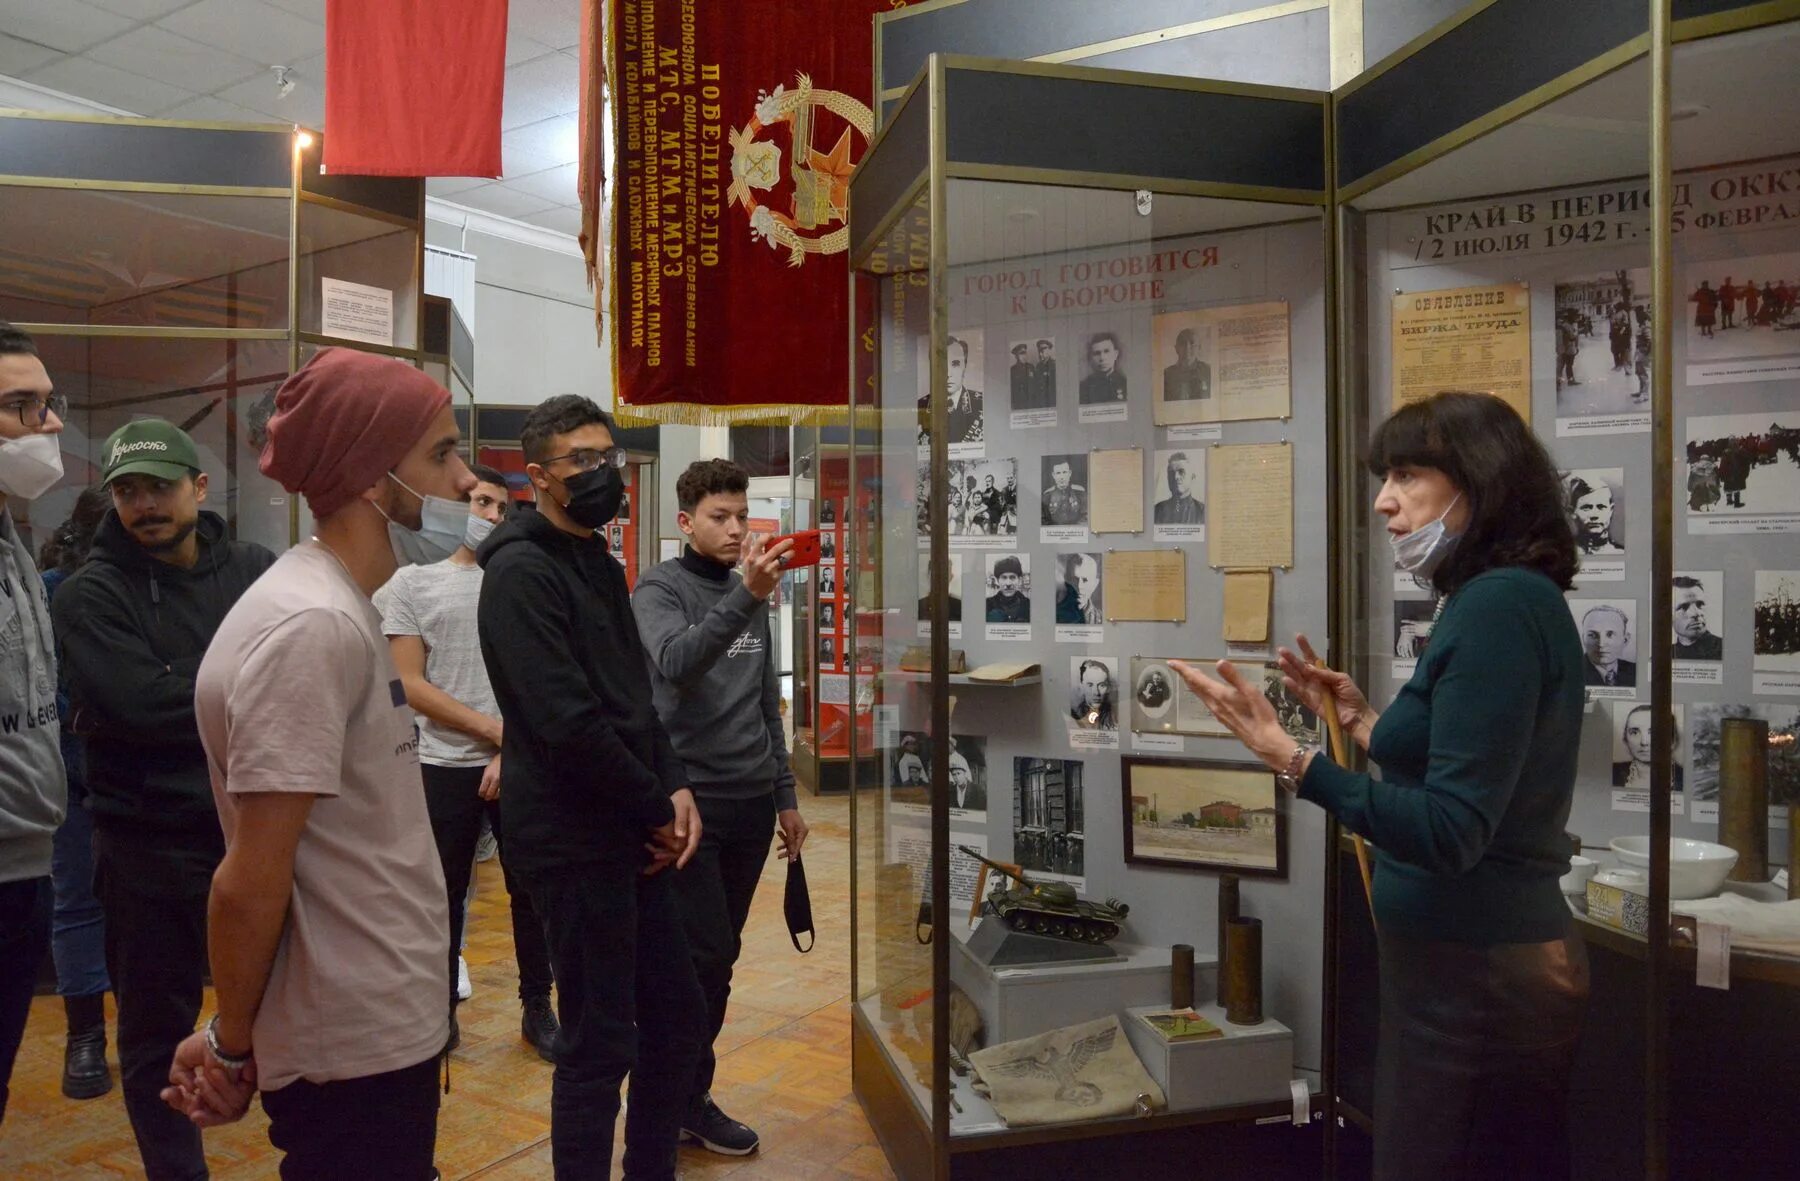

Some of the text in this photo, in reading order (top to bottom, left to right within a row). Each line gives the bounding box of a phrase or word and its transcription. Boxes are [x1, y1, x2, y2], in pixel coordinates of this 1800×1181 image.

[625, 0, 637, 51] МОНТА
[658, 45, 681, 113] МТС,
[628, 159, 637, 169] И
[641, 0, 661, 367] ПОЛНЕНИЕ И ПЕРЕВЫПОЛНЕНИЕ МЕСЯЧНЫХ ПЛАНОВ
[661, 129, 681, 197] МТМ
[683, 95, 697, 245] СОЦИАЛИСТИЧЕСКОМ
[701, 64, 720, 267] ПОБЕДИТЕЛЮ
[628, 176, 642, 250] СЛОЖНЫХ
[1426, 205, 1505, 235] КРАЙ
[1517, 203, 1535, 224] В
[1454, 233, 1530, 256] ИЮЛЯ
[1544, 220, 1606, 247] 1942
[662, 221, 683, 278] МРЗ
[964, 246, 1219, 296] ГОРОД ГОТОВИТСЯ
[631, 261, 643, 347] МОЛОТИЛОК
[685, 255, 697, 367] СОРЕВНОВАНИИ
[1011, 279, 1165, 314] К ОБОРОНЕ
[1401, 323, 1459, 335] БИРЖА
